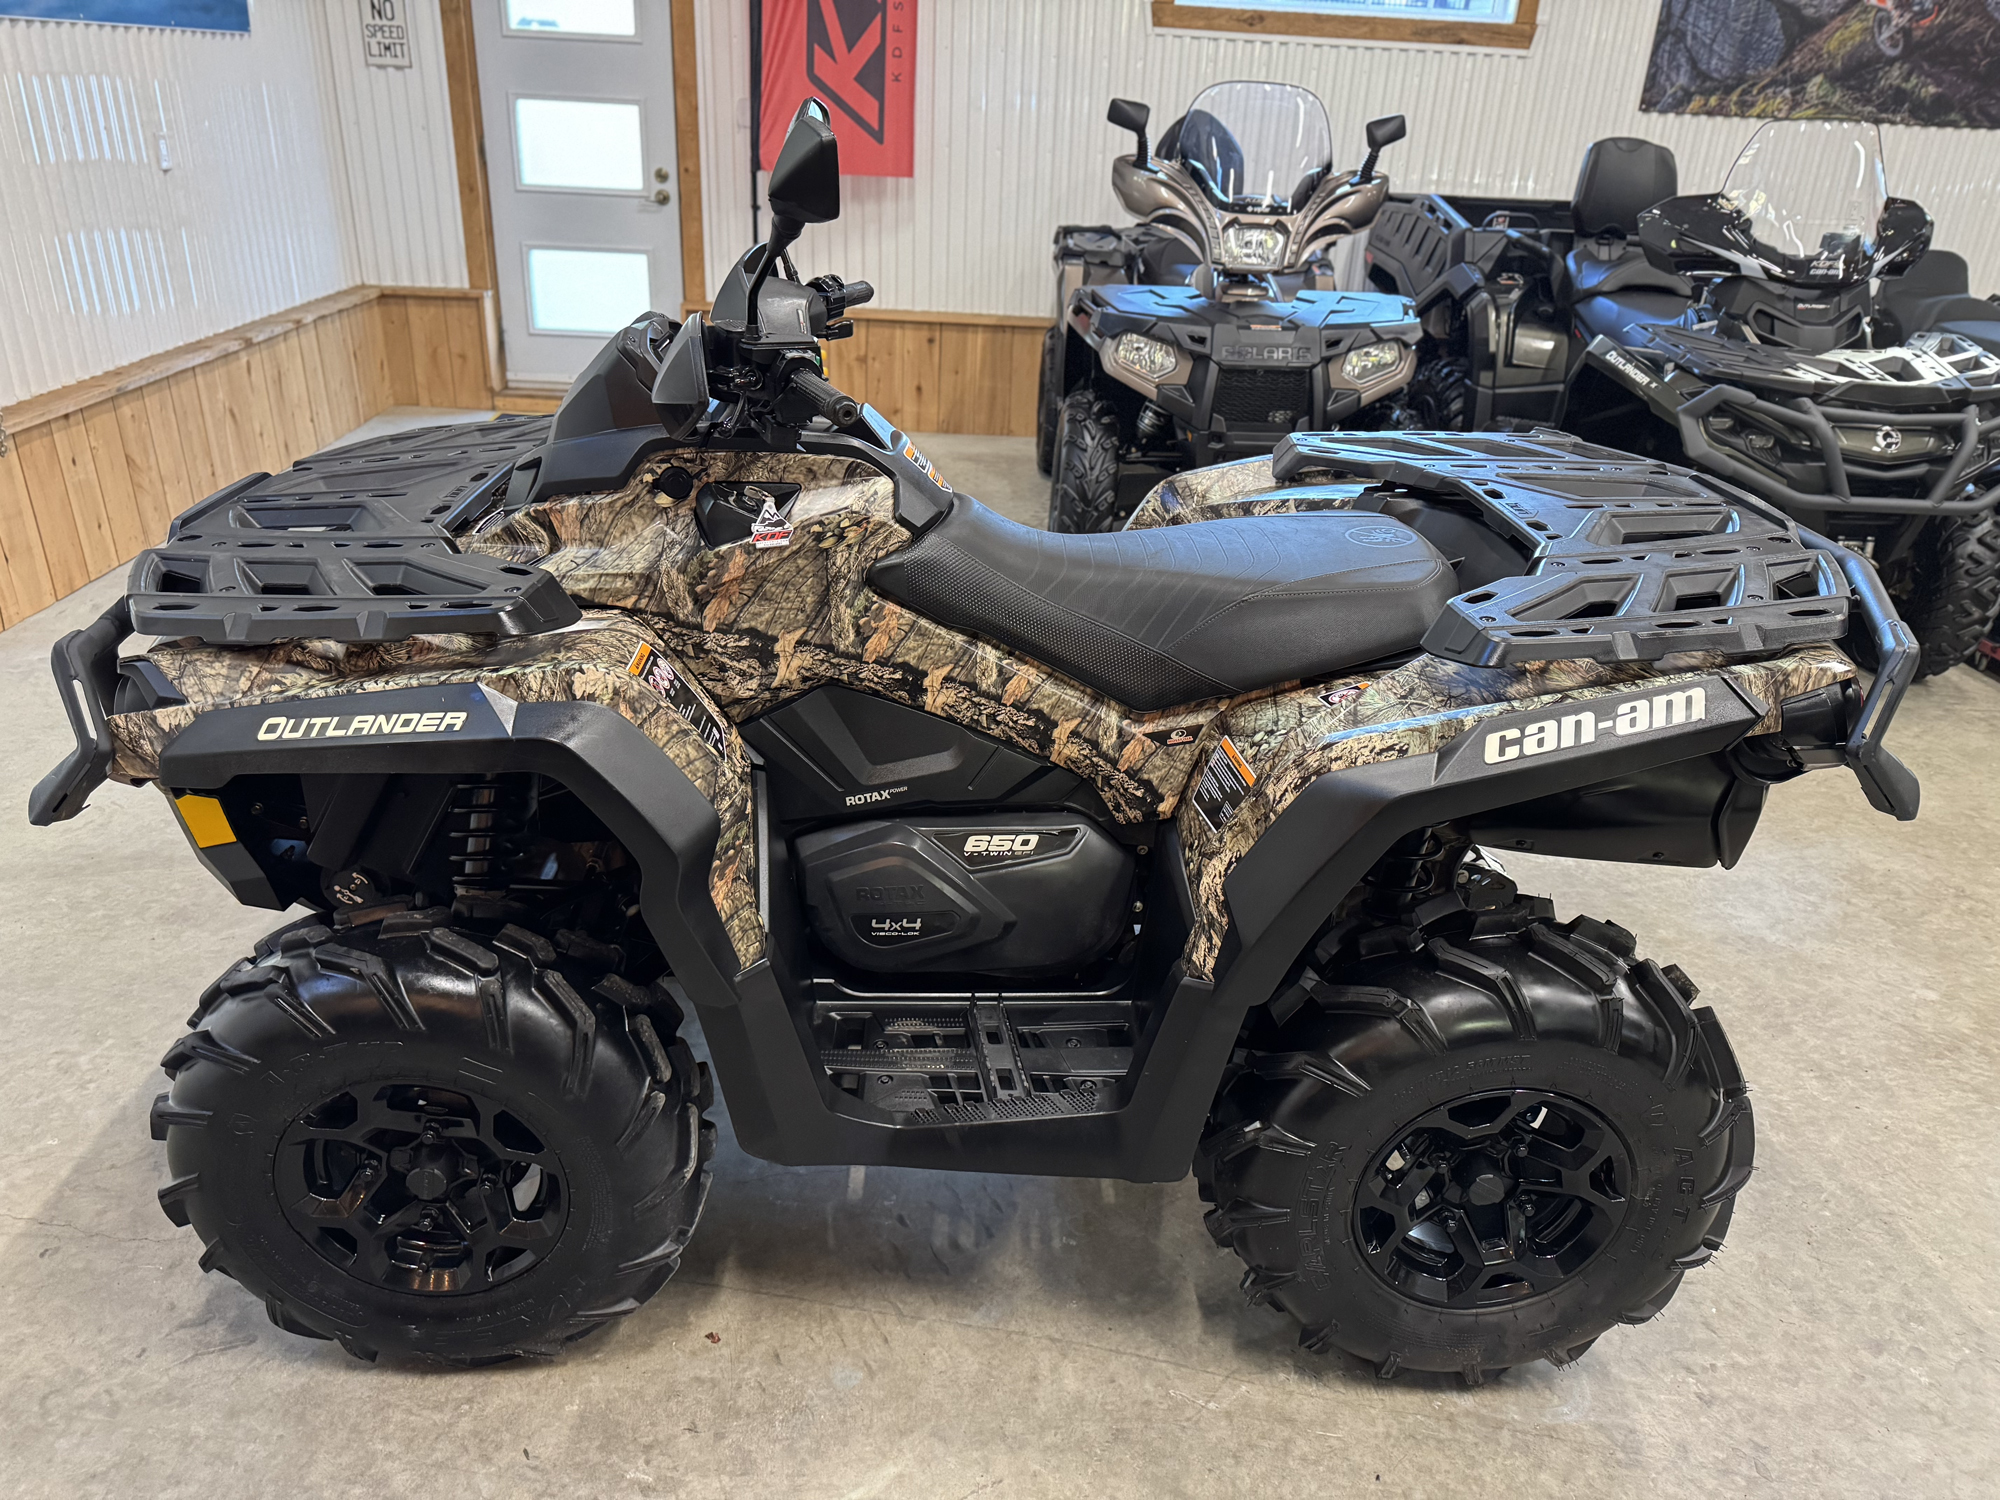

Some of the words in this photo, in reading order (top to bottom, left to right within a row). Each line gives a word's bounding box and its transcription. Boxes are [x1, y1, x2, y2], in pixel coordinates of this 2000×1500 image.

[369, 0, 395, 21] NO
[365, 23, 405, 40] SPEED
[367, 41, 406, 59] LIMIT
[1221, 346, 1312, 361] POLARIS
[1605, 350, 1651, 386] OUTLANDER
[752, 530, 793, 543] KDF
[257, 711, 468, 741] OUTLANDER
[1484, 687, 1706, 765] can-am
[845, 789, 891, 806] ROTAX
[889, 785, 908, 794] POWER
[963, 834, 1040, 852] 650
[856, 884, 925, 901] ROTAX
[871, 918, 922, 931] 4x4
